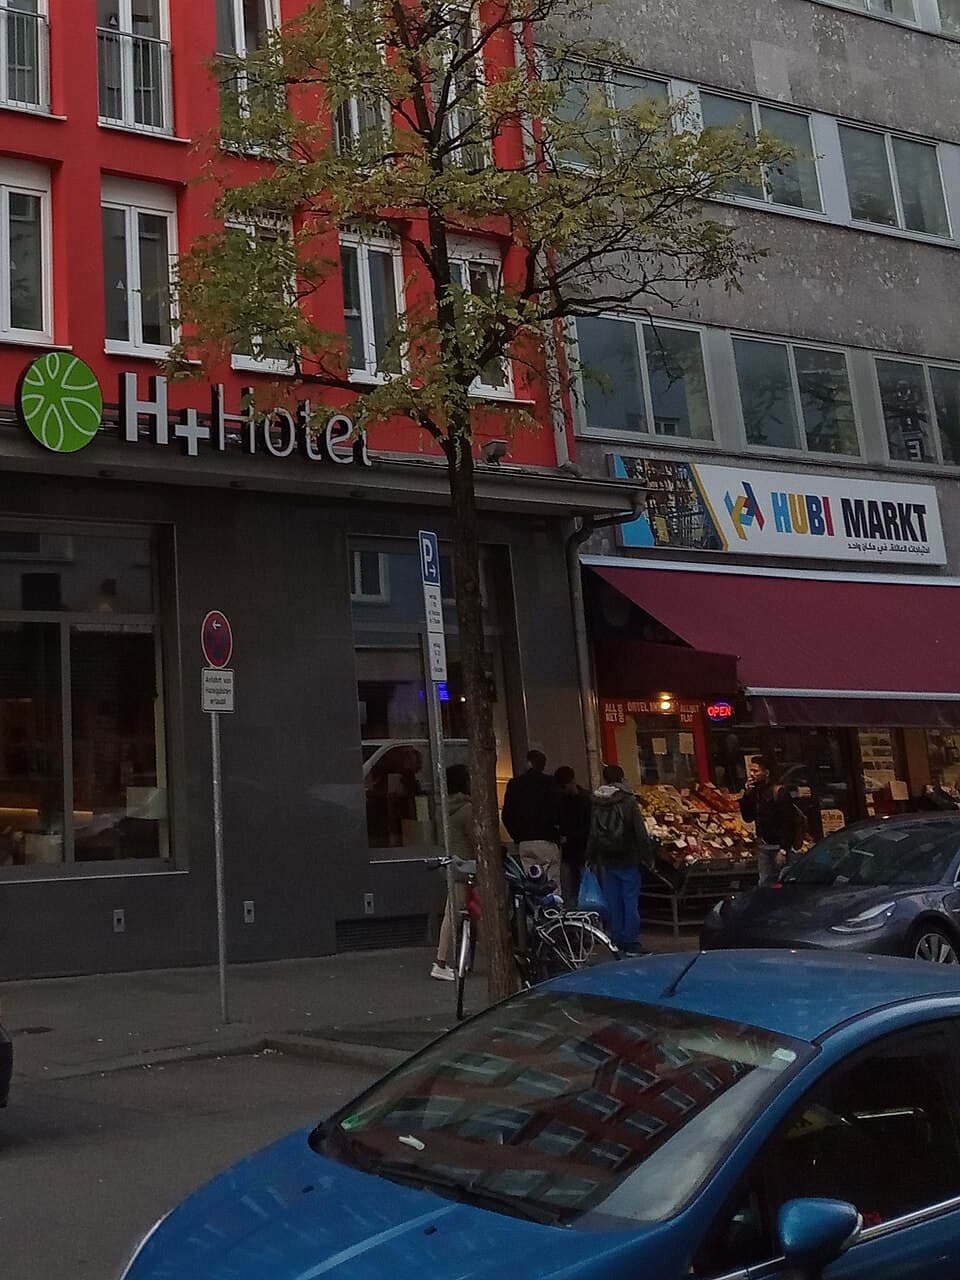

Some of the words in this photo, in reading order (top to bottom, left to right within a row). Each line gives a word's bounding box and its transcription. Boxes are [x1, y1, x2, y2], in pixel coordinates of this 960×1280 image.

[771, 492, 834, 536] HUBI
[840, 498, 928, 542] MARKT
[422, 538, 433, 577] P
[707, 704, 732, 717] OPEN
